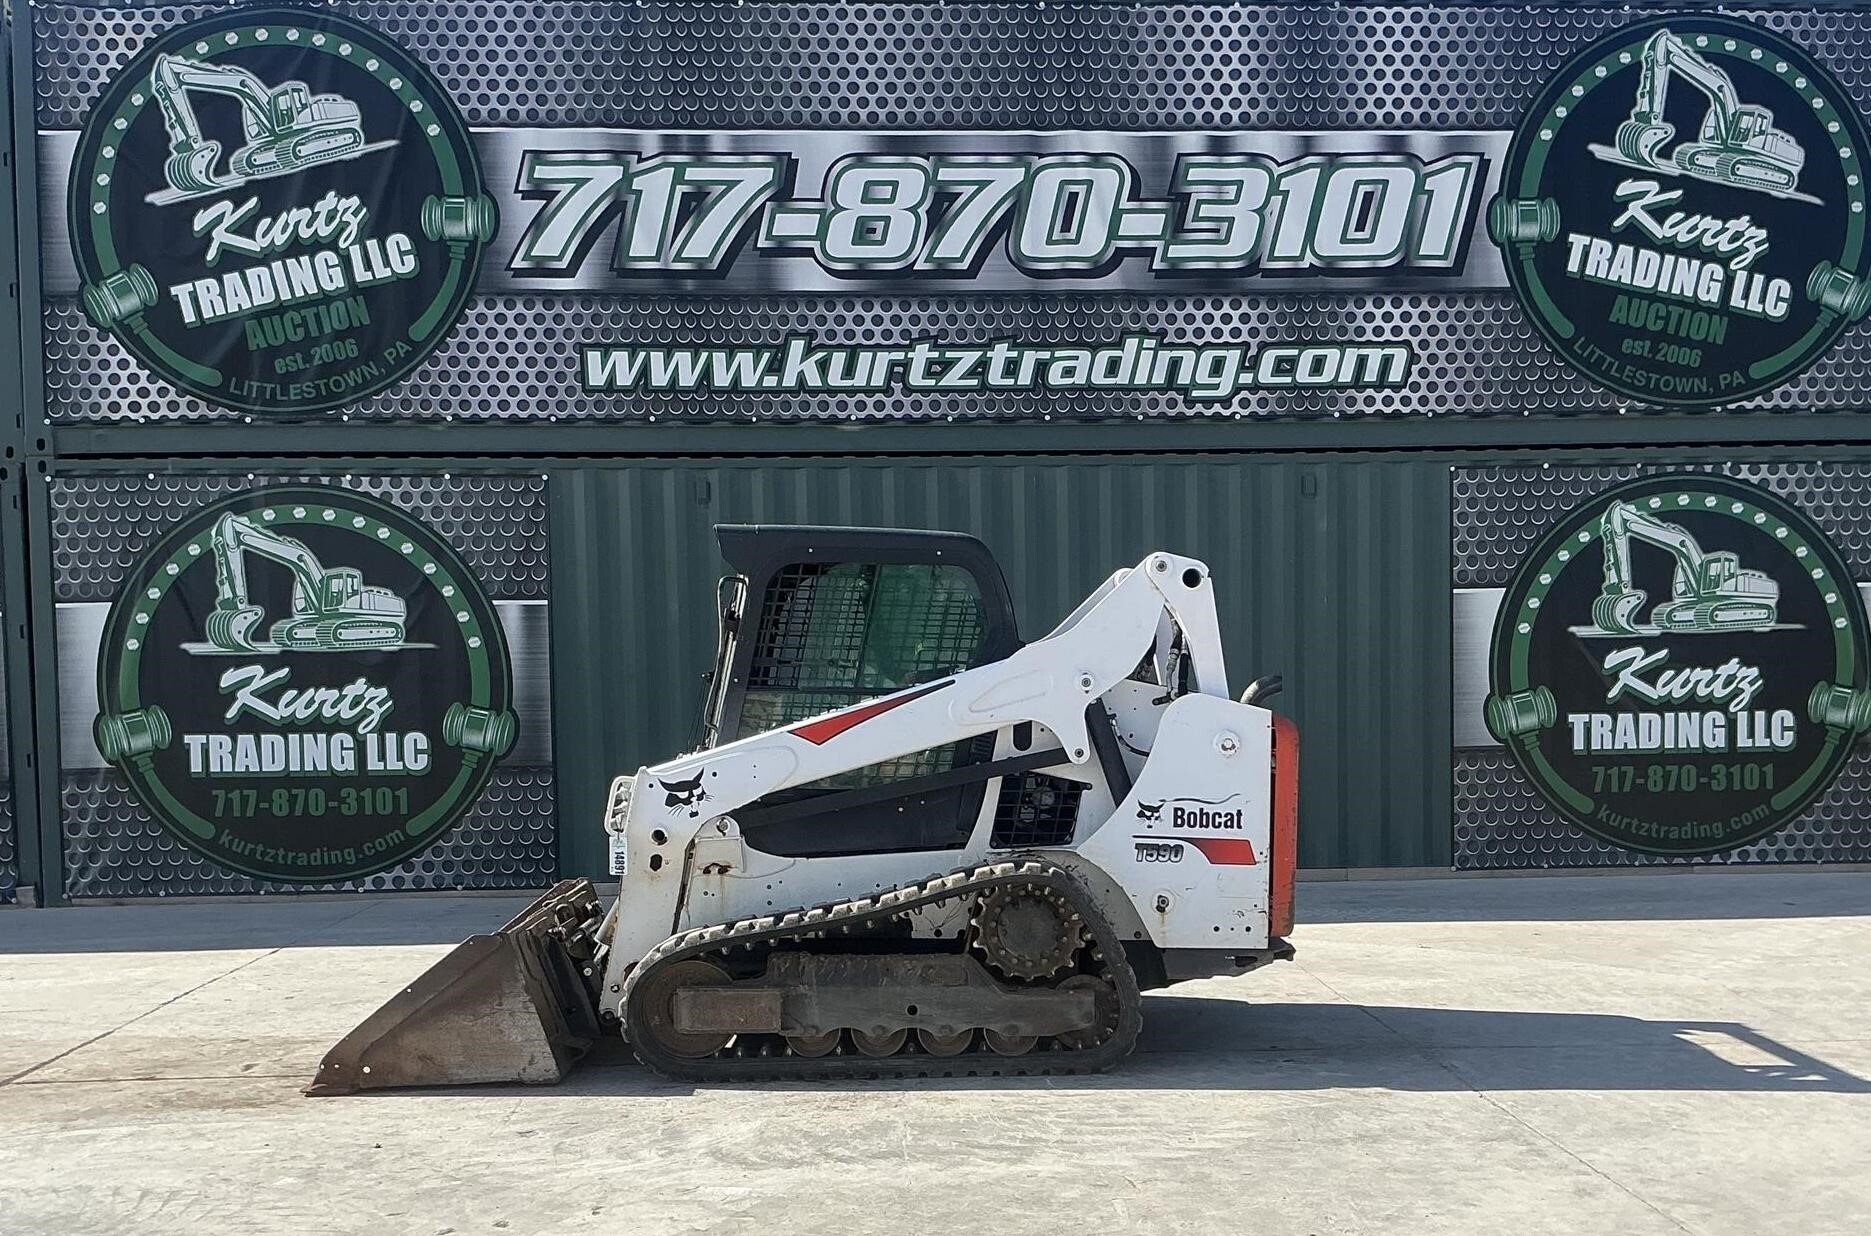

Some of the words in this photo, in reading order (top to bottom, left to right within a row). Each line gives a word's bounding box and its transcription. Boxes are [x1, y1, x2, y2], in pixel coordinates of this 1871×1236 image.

[194, 191, 367, 262] Kurtz
[508, 152, 1482, 274] 717-870-3101
[1612, 178, 1769, 269] Kurtz
[171, 251, 345, 324] TRADING
[347, 233, 416, 284] LLC
[1566, 233, 1724, 303] TRADING
[1729, 269, 1791, 318] LLC
[245, 296, 370, 351] AUCTION
[1609, 294, 1729, 345] AUCTION
[229, 360, 387, 401] LITTLESTOWN,
[385, 340, 413, 367] PA
[274, 352, 310, 373] est.
[311, 338, 359, 365] 2006
[582, 334, 1411, 399] www.kurtztrading.com
[1573, 337, 1714, 393] LITTLESTOWN,
[1719, 372, 1746, 389] PA
[1621, 337, 1652, 359] est.
[1655, 342, 1702, 368] 2006
[220, 665, 393, 734] Kurtz
[1603, 646, 1763, 713] Kurtz
[183, 732, 355, 774] TRADING
[364, 732, 430, 773] LLC
[1568, 712, 1727, 750] TRADING
[1736, 710, 1796, 749] LLC
[211, 786, 409, 818] 717-870-3101
[1592, 763, 1775, 793] 717-870-3101
[1172, 807, 1243, 830] Bobcat
[1597, 804, 1769, 841] kurtztrading.com
[218, 828, 405, 867] kurtztrading.com
[614, 851, 625, 875] 14891
[1134, 842, 1184, 863] T590
